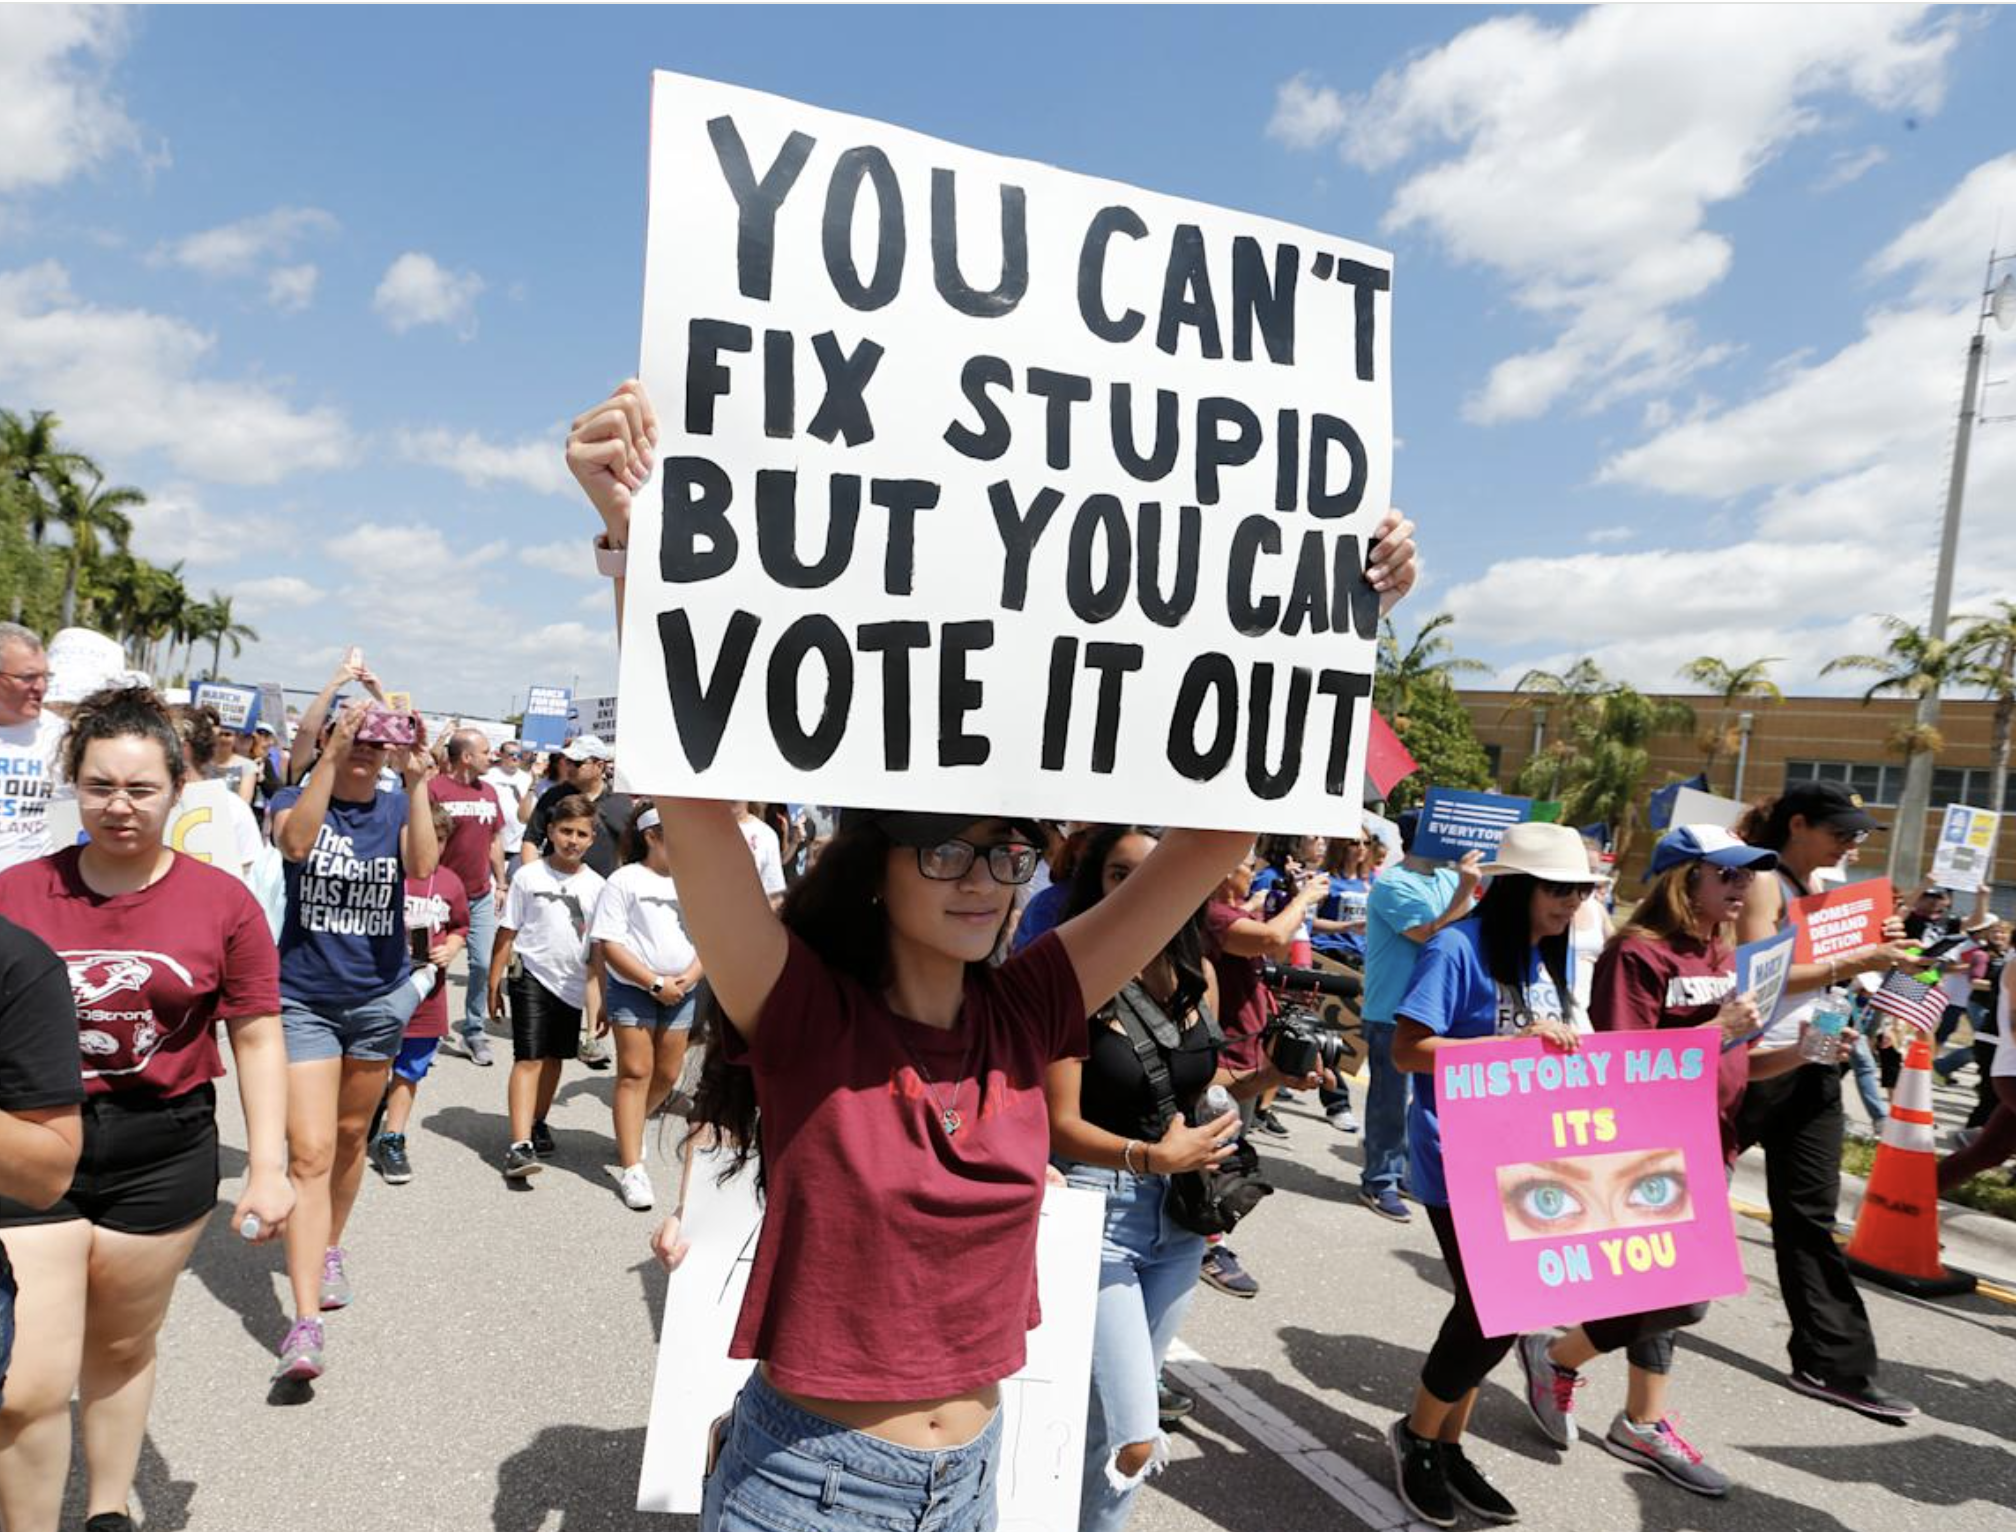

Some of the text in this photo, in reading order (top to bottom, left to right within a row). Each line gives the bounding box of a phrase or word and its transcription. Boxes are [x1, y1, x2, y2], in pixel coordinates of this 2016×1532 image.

[707, 115, 1389, 381] YOU CAN'T
[685, 318, 1367, 519] FIX STUPID
[660, 456, 1380, 640] BUT YOU CAN
[657, 608, 1372, 800] VOTE IT OUT
[5, 780, 53, 799] OUR
[306, 848, 398, 883] TEACHER
[299, 875, 393, 910] HAS HAD
[300, 902, 395, 936] #ENOUGH
[1809, 914, 1869, 941] DEMAND
[1812, 930, 1863, 957] ACTION
[1445, 1048, 1704, 1100] HISTORY HAS
[1552, 1107, 1617, 1148] ITS
[1537, 1231, 1676, 1287] ON YOU
